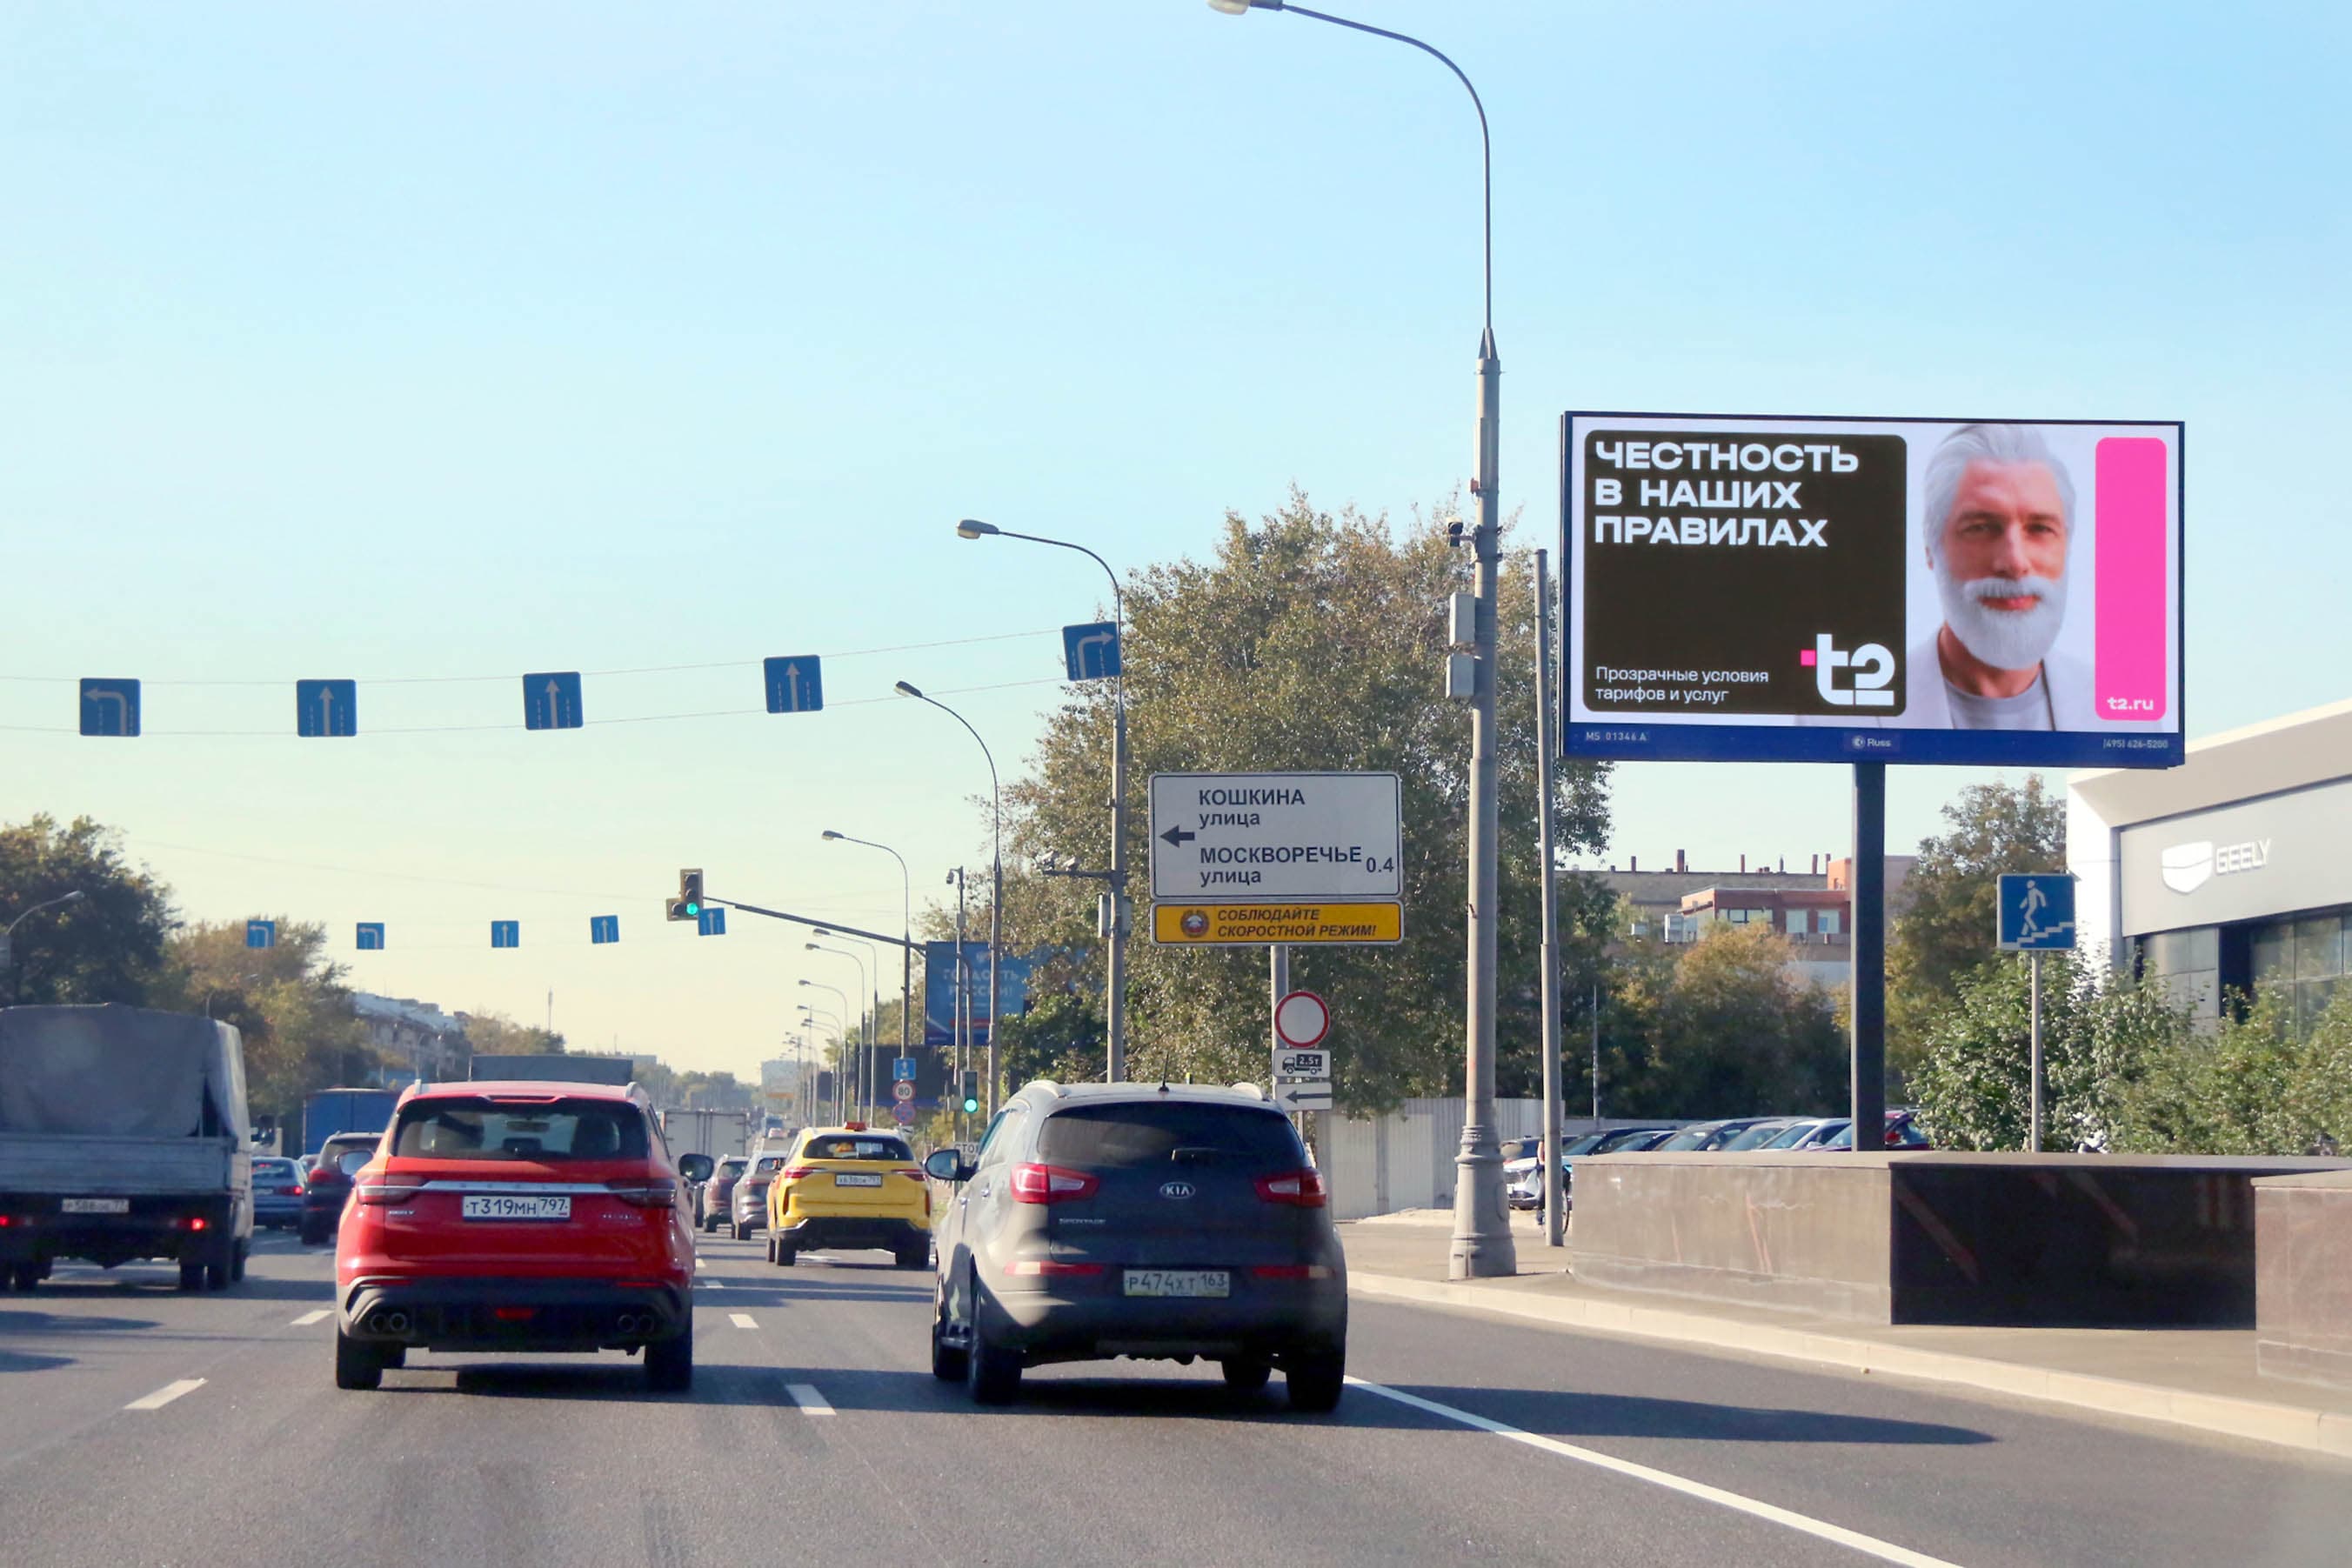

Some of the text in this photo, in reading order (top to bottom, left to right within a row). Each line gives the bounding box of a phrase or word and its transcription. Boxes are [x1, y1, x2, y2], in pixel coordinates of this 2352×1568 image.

[1594, 442, 1859, 473] ЧЕСТНОСТЬ
[1594, 479, 1802, 510] В НАШИХ
[1594, 516, 1828, 548] ПРАВИЛАХ
[1595, 666, 1769, 686] Прозрачные условия
[1594, 686, 1729, 704] тарифов и услуг
[2108, 697, 2155, 711] t2.ru
[1199, 789, 1306, 805] КОШКИНА
[1199, 811, 1260, 830] улица
[1200, 847, 1362, 864] МОСКВОРЕЧЬЕ
[2215, 837, 2272, 876] GEELY
[1366, 857, 1394, 873] 0.4
[1200, 869, 1261, 887] улица
[1218, 909, 1320, 921] СОБЛЮДАЙТЕ
[1218, 924, 1376, 937] СКОРОСТНОЙ РЕЖИМ!
[898, 1087, 910, 1096] 80
[953, 1144, 979, 1152] СТО
[1165, 1186, 1190, 1195] KIA
[470, 1198, 537, 1215] Т319МН
